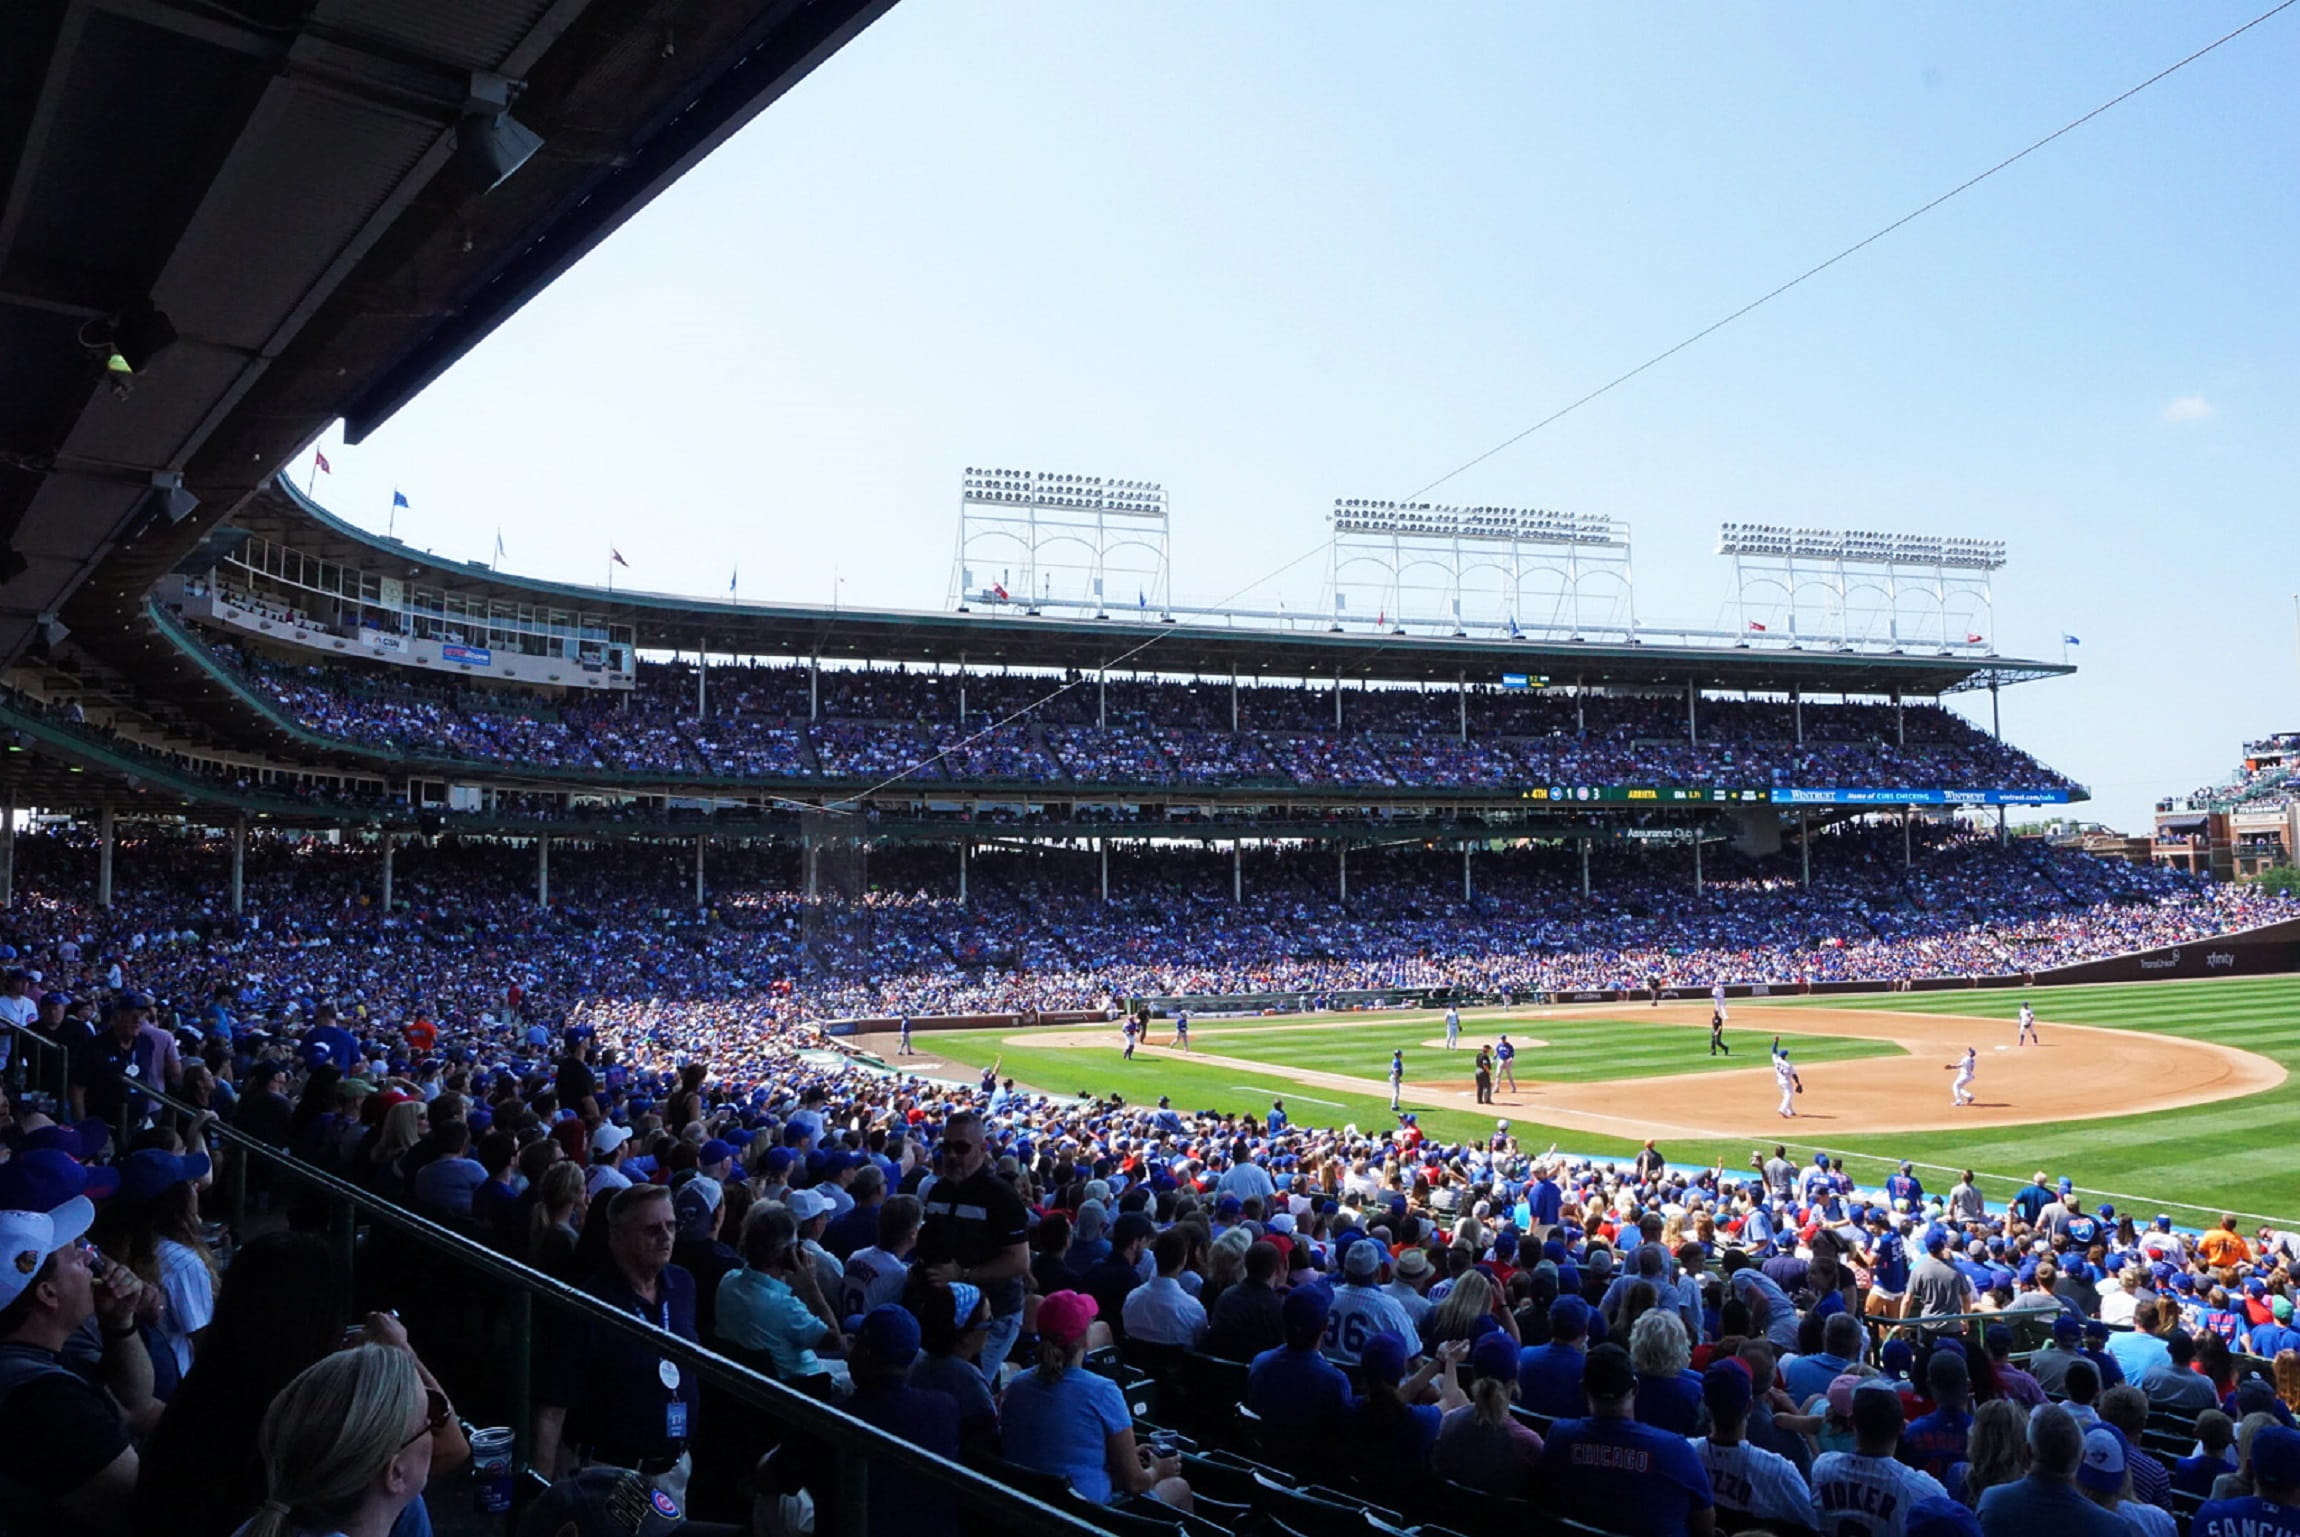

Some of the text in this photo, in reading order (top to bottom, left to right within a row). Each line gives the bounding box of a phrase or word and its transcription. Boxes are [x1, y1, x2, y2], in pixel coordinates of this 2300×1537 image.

[1567, 788, 1573, 800] 1
[1593, 788, 1600, 800] 3
[1790, 789, 1836, 801] WINTRUST
[1627, 828, 1693, 838] Assurance Club
[2206, 951, 2235, 968] xfinity
[1569, 1442, 1649, 1473] CHICAGO
